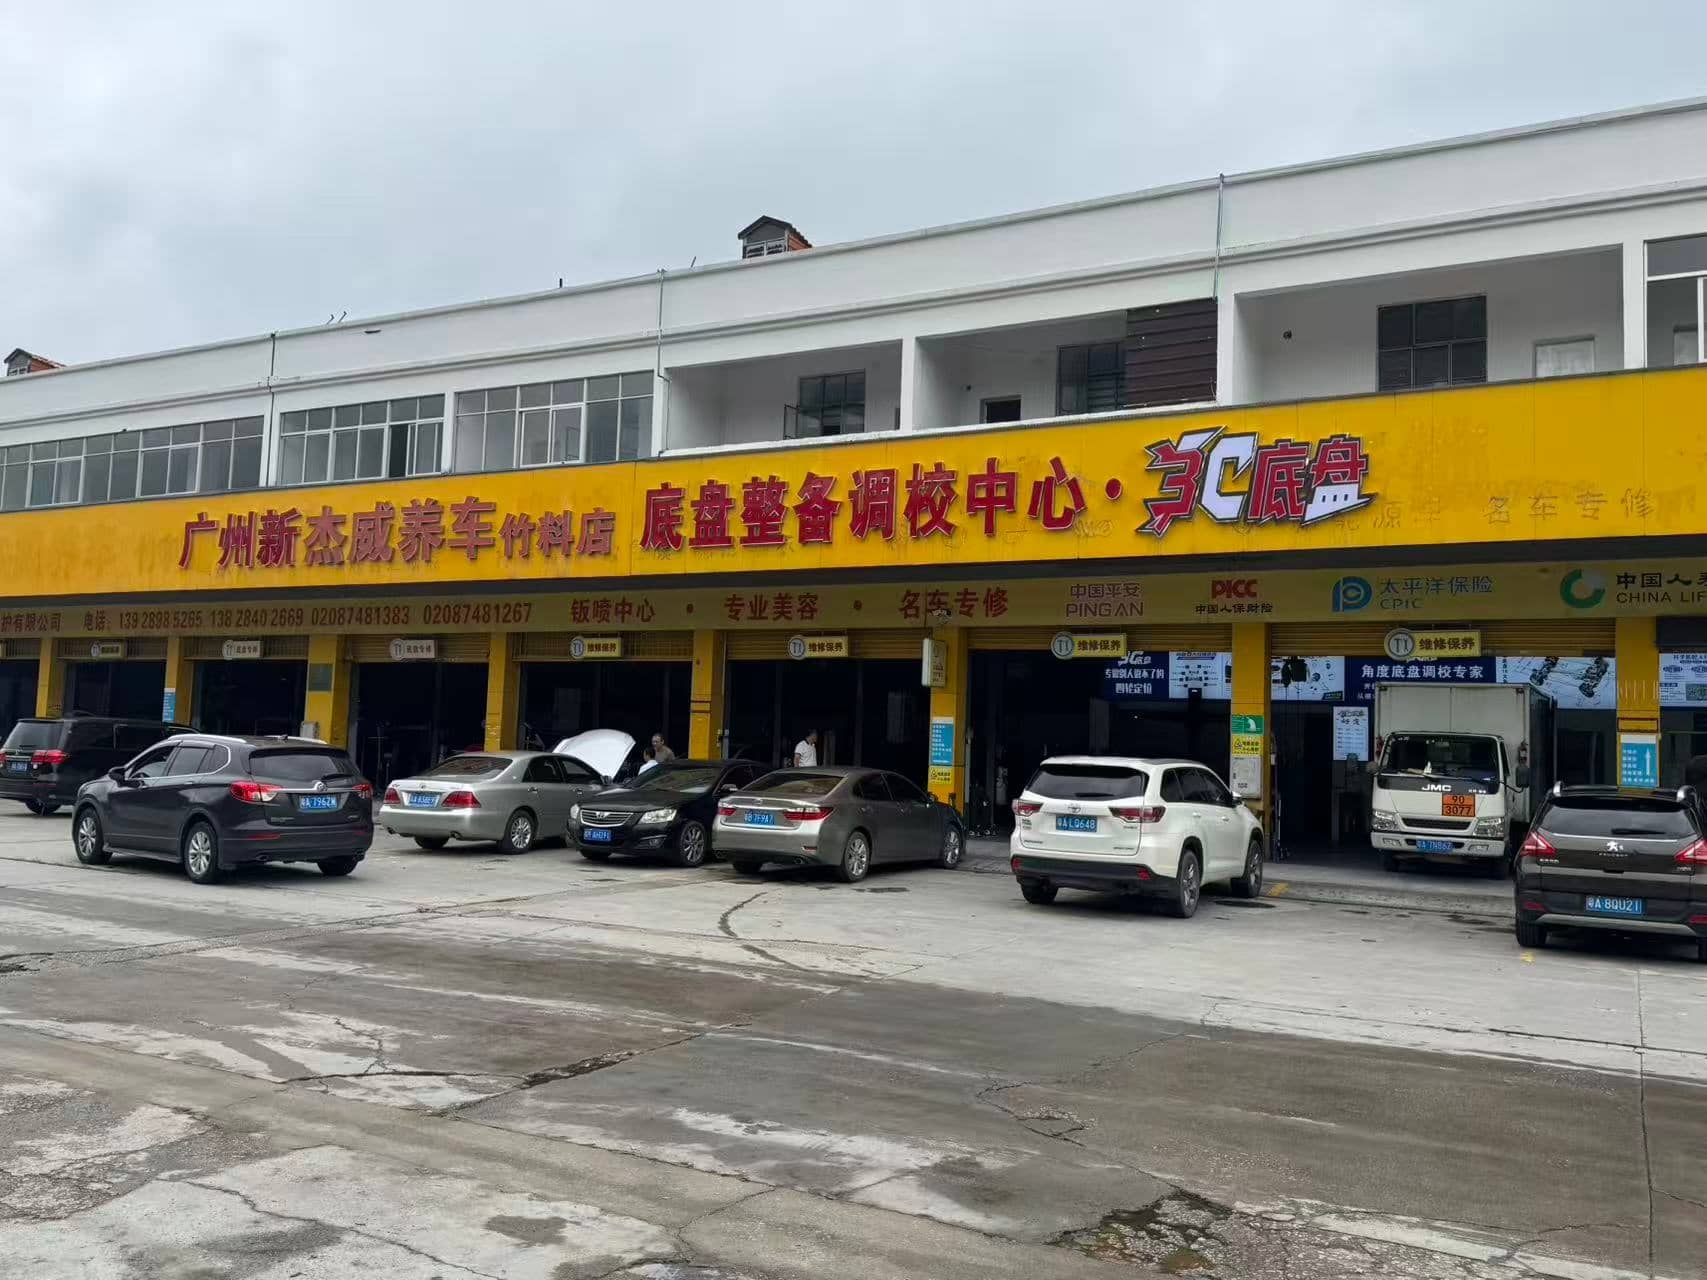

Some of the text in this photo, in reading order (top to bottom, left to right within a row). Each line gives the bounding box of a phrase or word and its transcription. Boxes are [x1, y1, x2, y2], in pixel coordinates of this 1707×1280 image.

[178, 495, 616, 568] 广州新杰威养车竹料店
[1070, 583, 1140, 599] 中国平安
[1211, 579, 1257, 599] PICC
[1380, 576, 1492, 596] 太平洋保险
[901, 587, 1009, 620] 名车专修
[1616, 591, 1672, 603] CHINA
[311, 605, 409, 626] 02087481383
[423, 602, 532, 624] 02087481267
[570, 598, 656, 624] 钣喷中心
[723, 593, 819, 621] 专业美容
[1195, 603, 1273, 614] 中国人保财险
[808, 642, 843, 652] 维修保养
[1077, 640, 1121, 651] 维修保养
[1418, 638, 1475, 650] 维修保养
[1361, 665, 1484, 679] 角度底盘调校专家
[1421, 784, 1452, 792] JMC
[1452, 795, 1465, 804] 90
[1446, 806, 1472, 815] 3077
